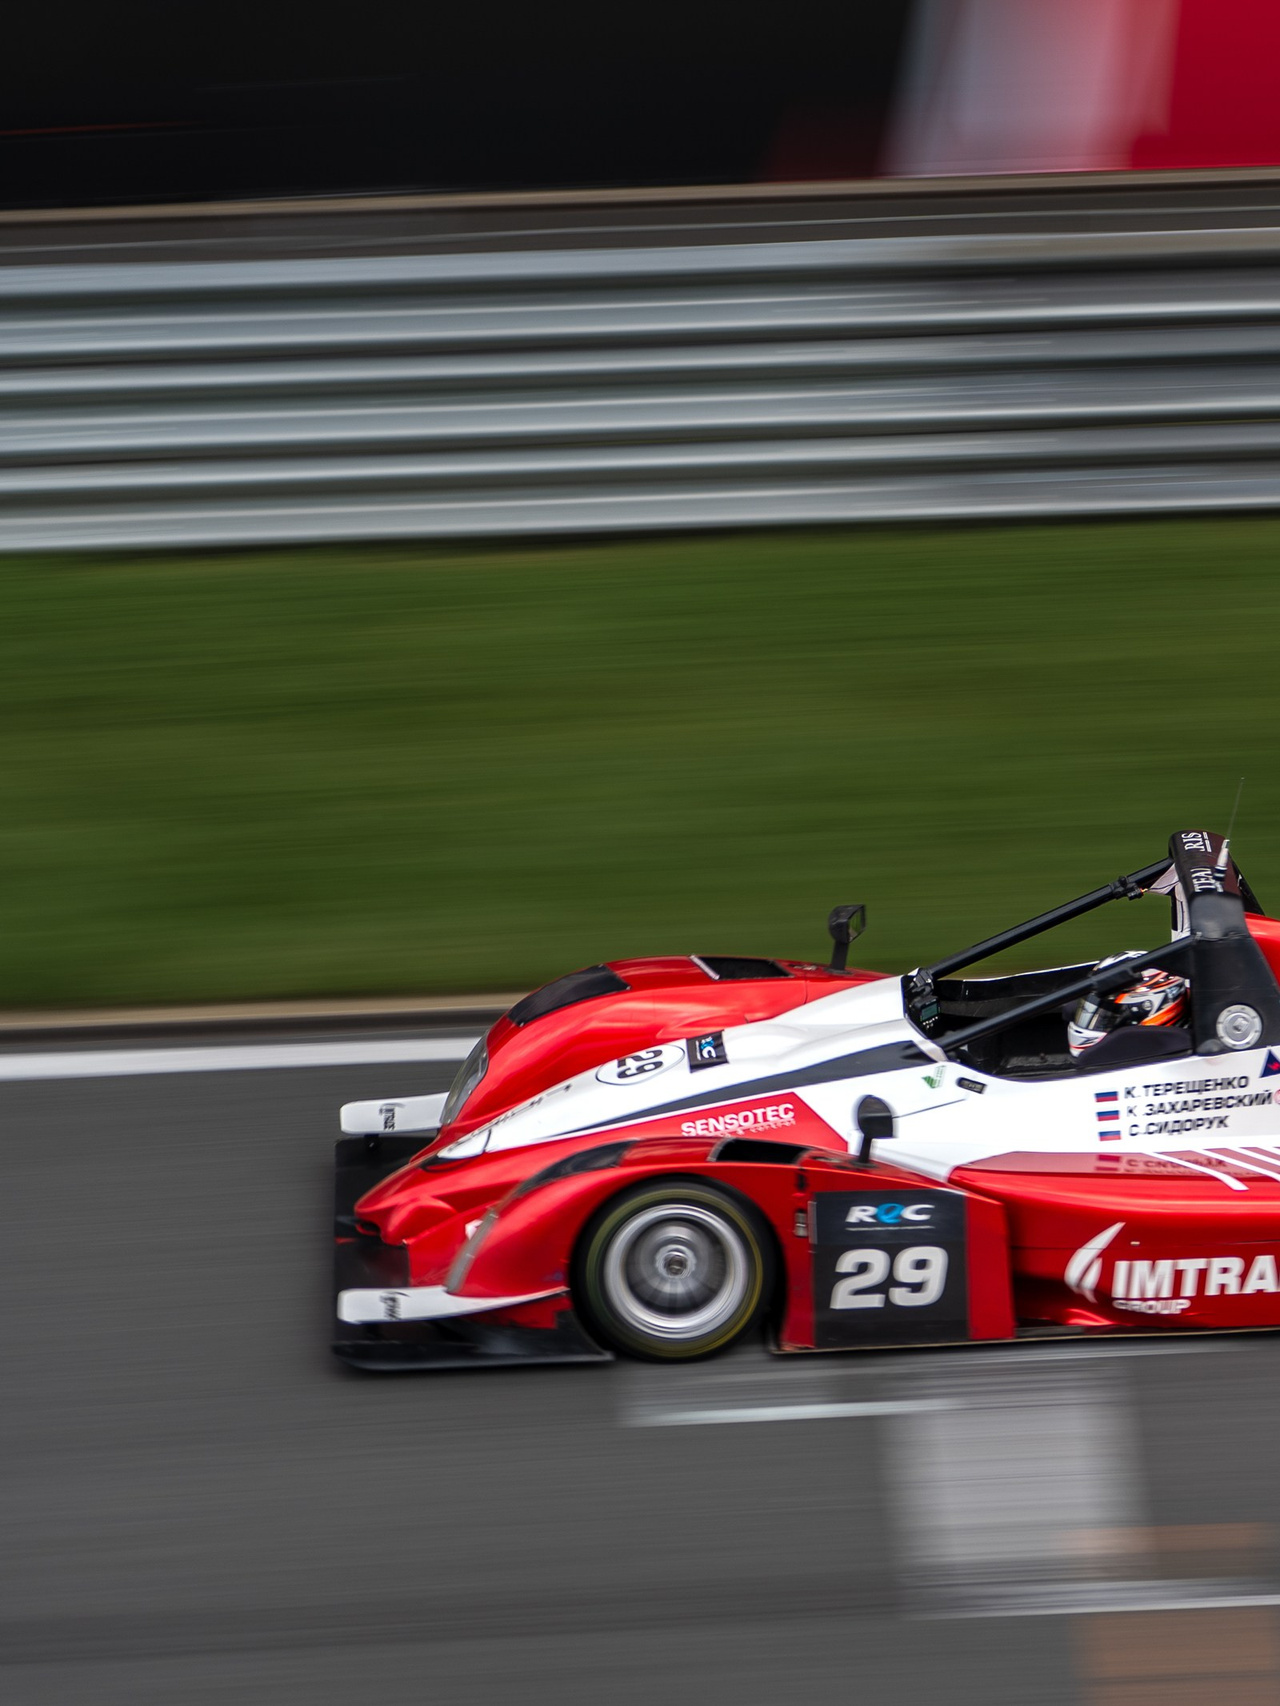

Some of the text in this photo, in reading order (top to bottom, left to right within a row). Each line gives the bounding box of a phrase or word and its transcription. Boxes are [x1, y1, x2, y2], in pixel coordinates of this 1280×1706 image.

[616, 1049, 664, 1080] 29
[681, 1103, 795, 1137] SENSOTEC
[829, 1246, 949, 1310] 29
[1112, 1299, 1191, 1314] GROUP
